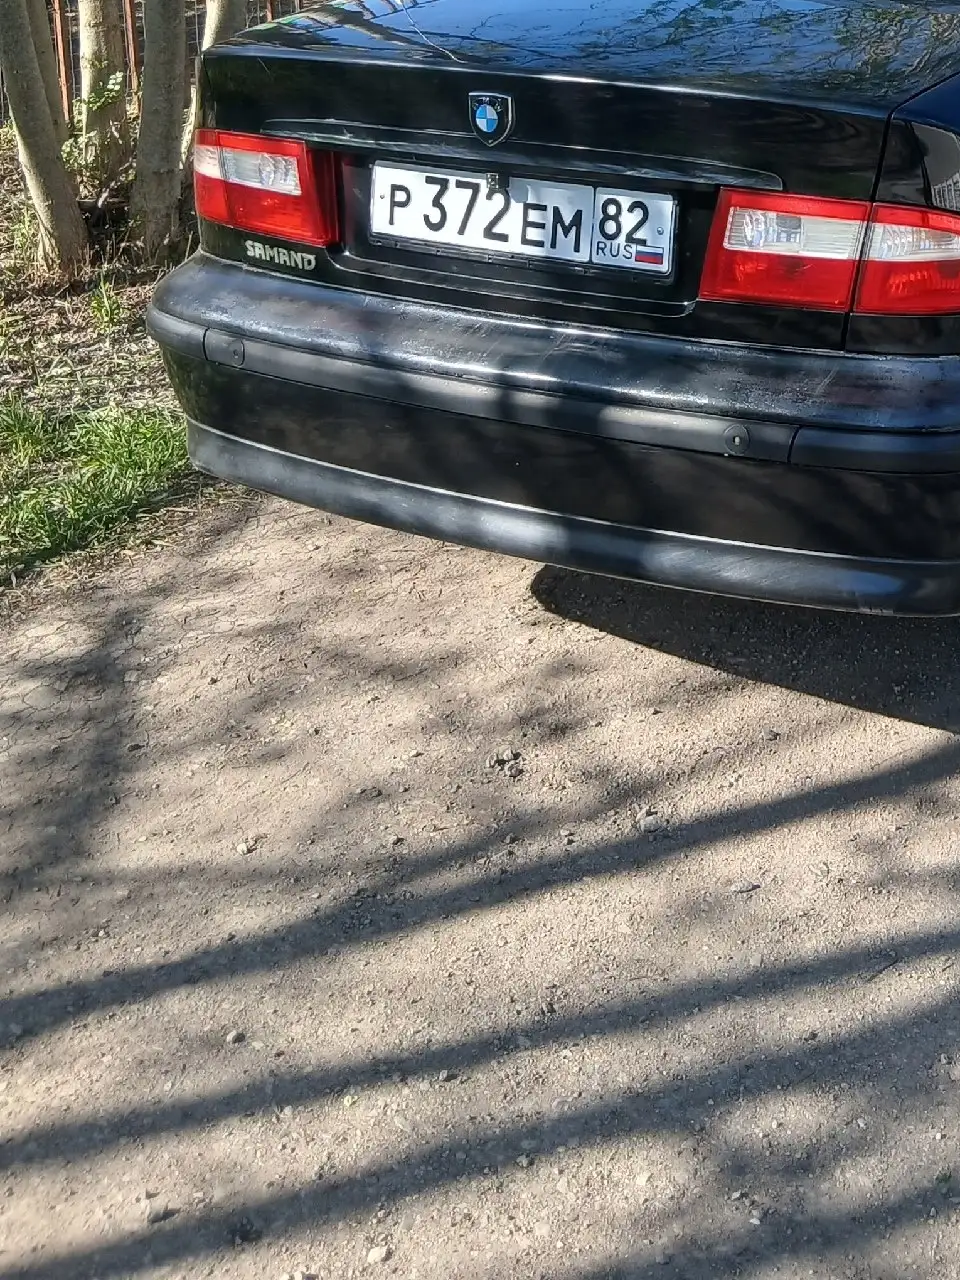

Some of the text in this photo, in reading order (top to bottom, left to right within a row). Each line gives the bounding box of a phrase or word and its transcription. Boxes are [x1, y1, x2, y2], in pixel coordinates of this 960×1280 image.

[598, 197, 650, 246] 82
[244, 239, 317, 271] SAMAND
[596, 240, 633, 260] RUS
